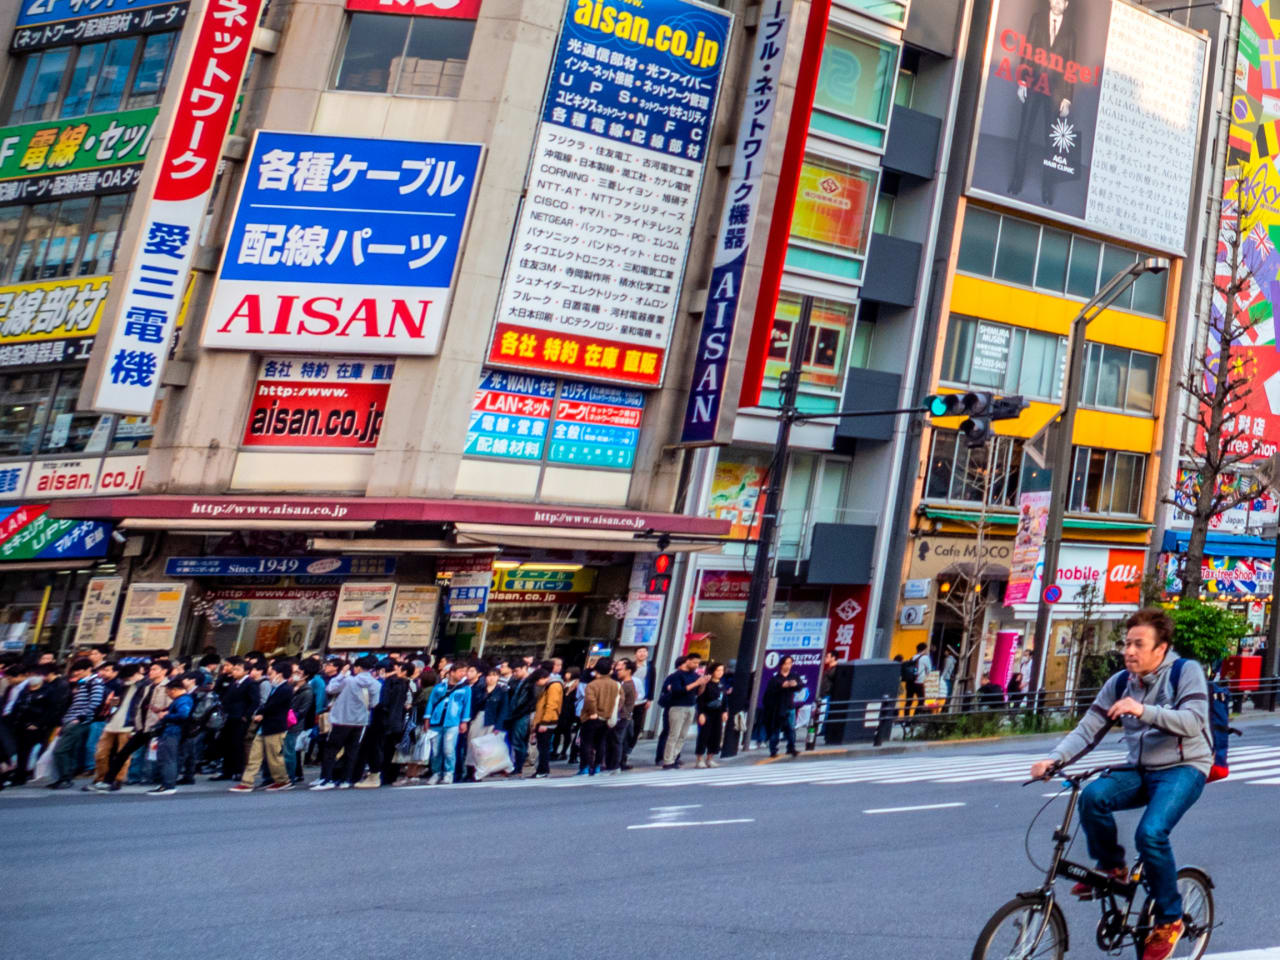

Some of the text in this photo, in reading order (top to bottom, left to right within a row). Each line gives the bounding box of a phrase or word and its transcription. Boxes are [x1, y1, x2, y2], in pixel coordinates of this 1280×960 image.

[994, 57, 1051, 96] AGA
[1000, 29, 1101, 86] Change!
[259, 149, 464, 197] 各種ケーブル
[1052, 154, 1067, 165] AGA
[237, 223, 447, 269] 配線パーツ
[110, 221, 190, 388] 愛三電機
[217, 294, 432, 338] AISAN
[501, 331, 658, 375] 各社 特約 在庫 直販
[692, 272, 734, 423] AISAN
[265, 360, 292, 378] 各社
[337, 362, 363, 380] 在庫
[191, 502, 348, 516] http://www.aisan.co.jp
[534, 511, 645, 528] http://www.aisan.co.jp
[228, 558, 299, 573] Since 1949
[934, 545, 960, 558] Cafe
[1110, 565, 1137, 582] au
